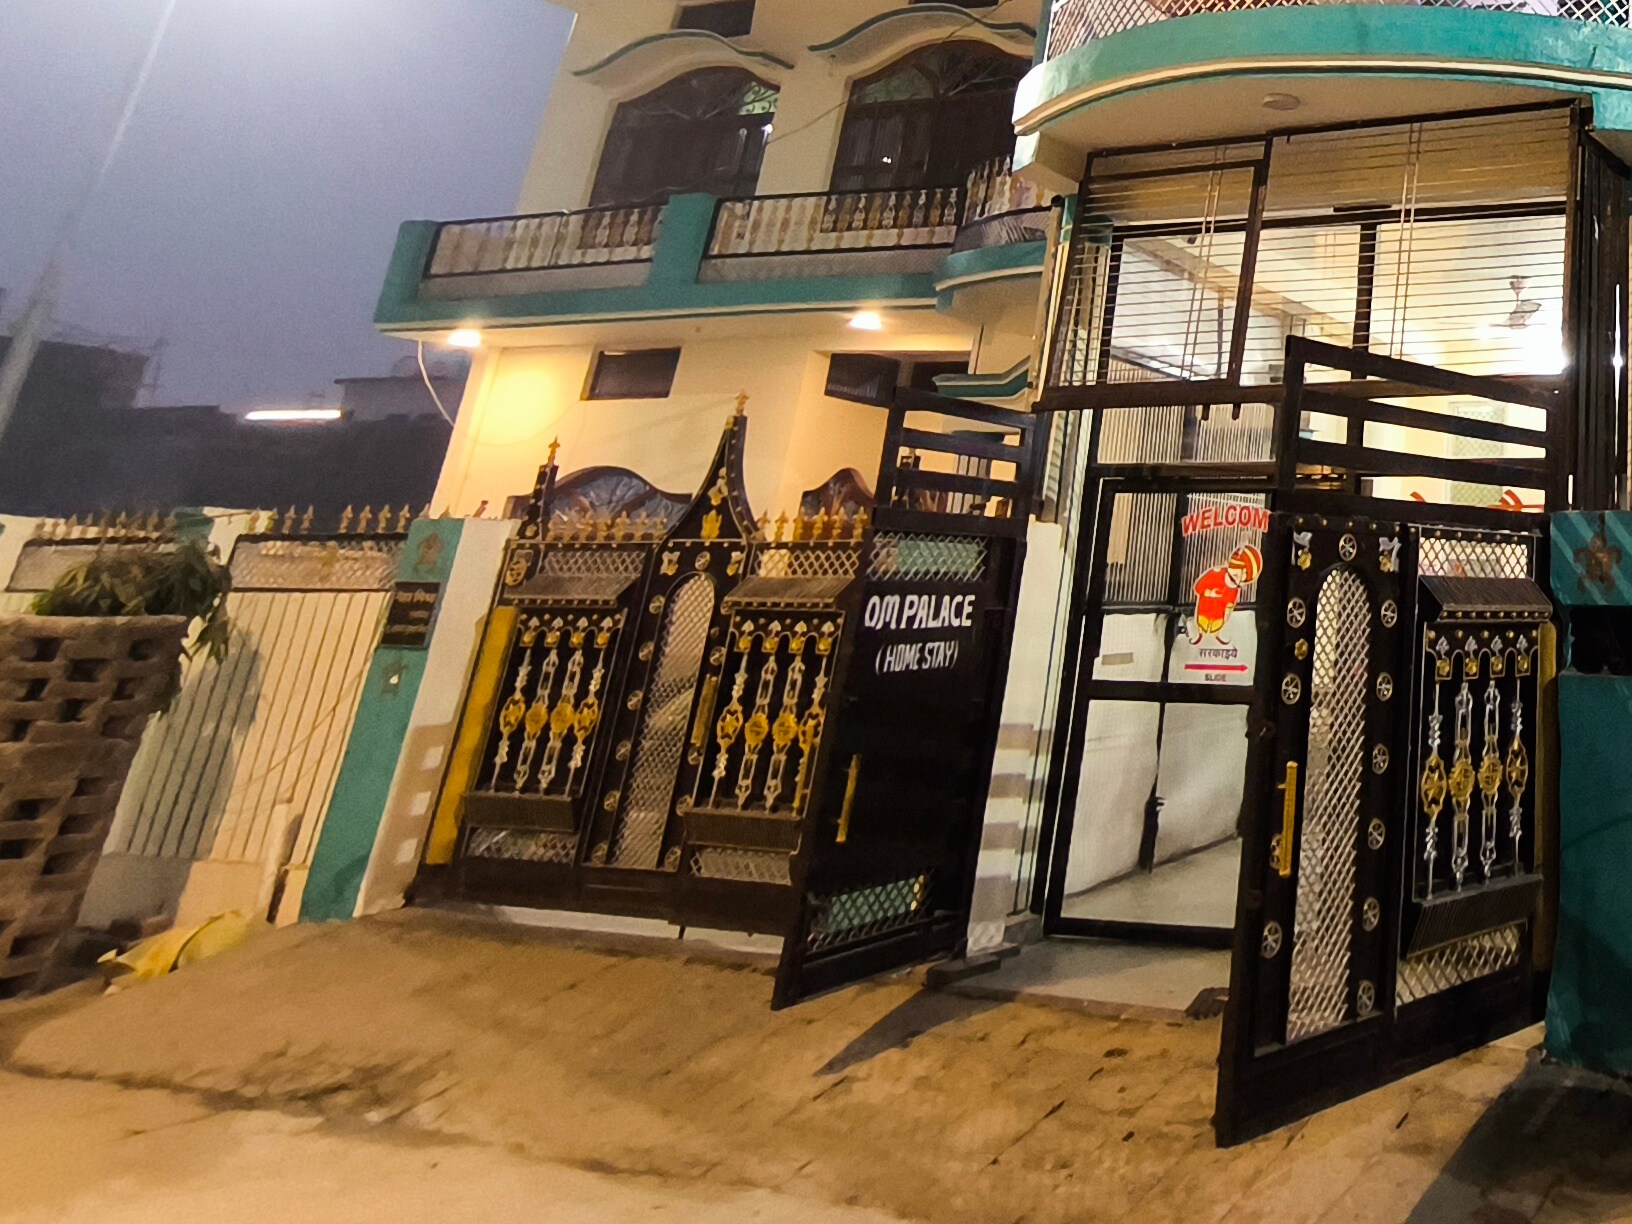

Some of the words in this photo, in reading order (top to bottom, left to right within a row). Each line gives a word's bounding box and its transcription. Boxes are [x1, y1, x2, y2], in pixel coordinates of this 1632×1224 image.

[1183, 505, 1270, 536] WELCOM
[864, 594, 900, 630] OM
[900, 594, 976, 629] PALACE
